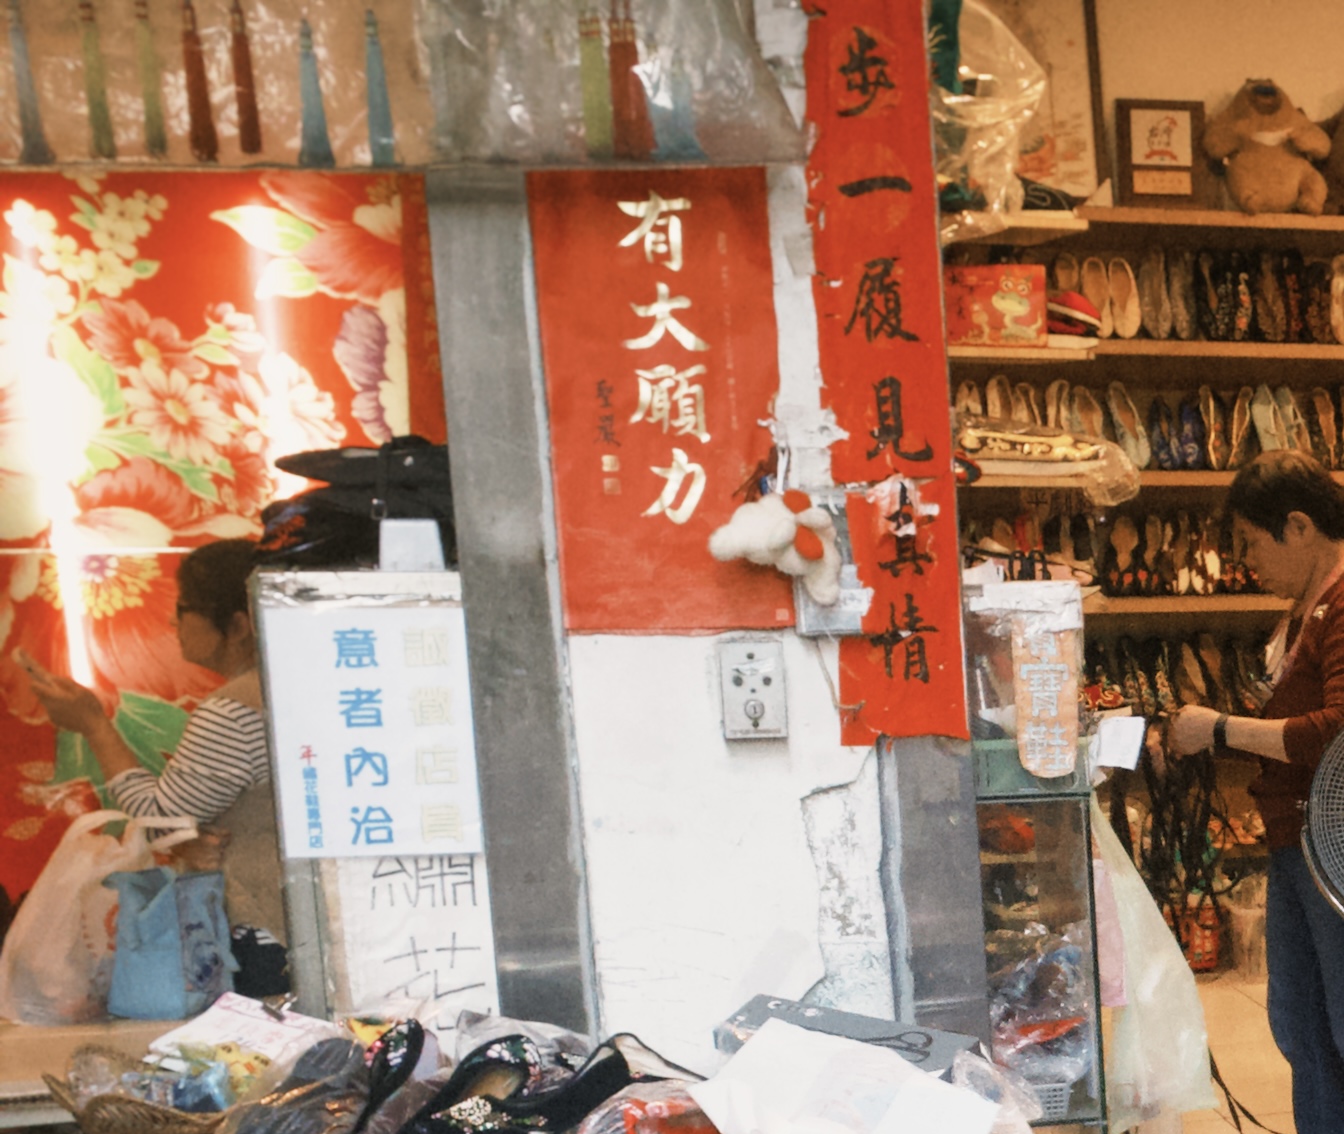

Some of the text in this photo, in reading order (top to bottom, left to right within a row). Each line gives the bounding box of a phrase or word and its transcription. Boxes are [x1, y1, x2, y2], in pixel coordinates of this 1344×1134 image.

[617, 190, 711, 524] 有大願力
[332, 628, 394, 846] 意者內洽
